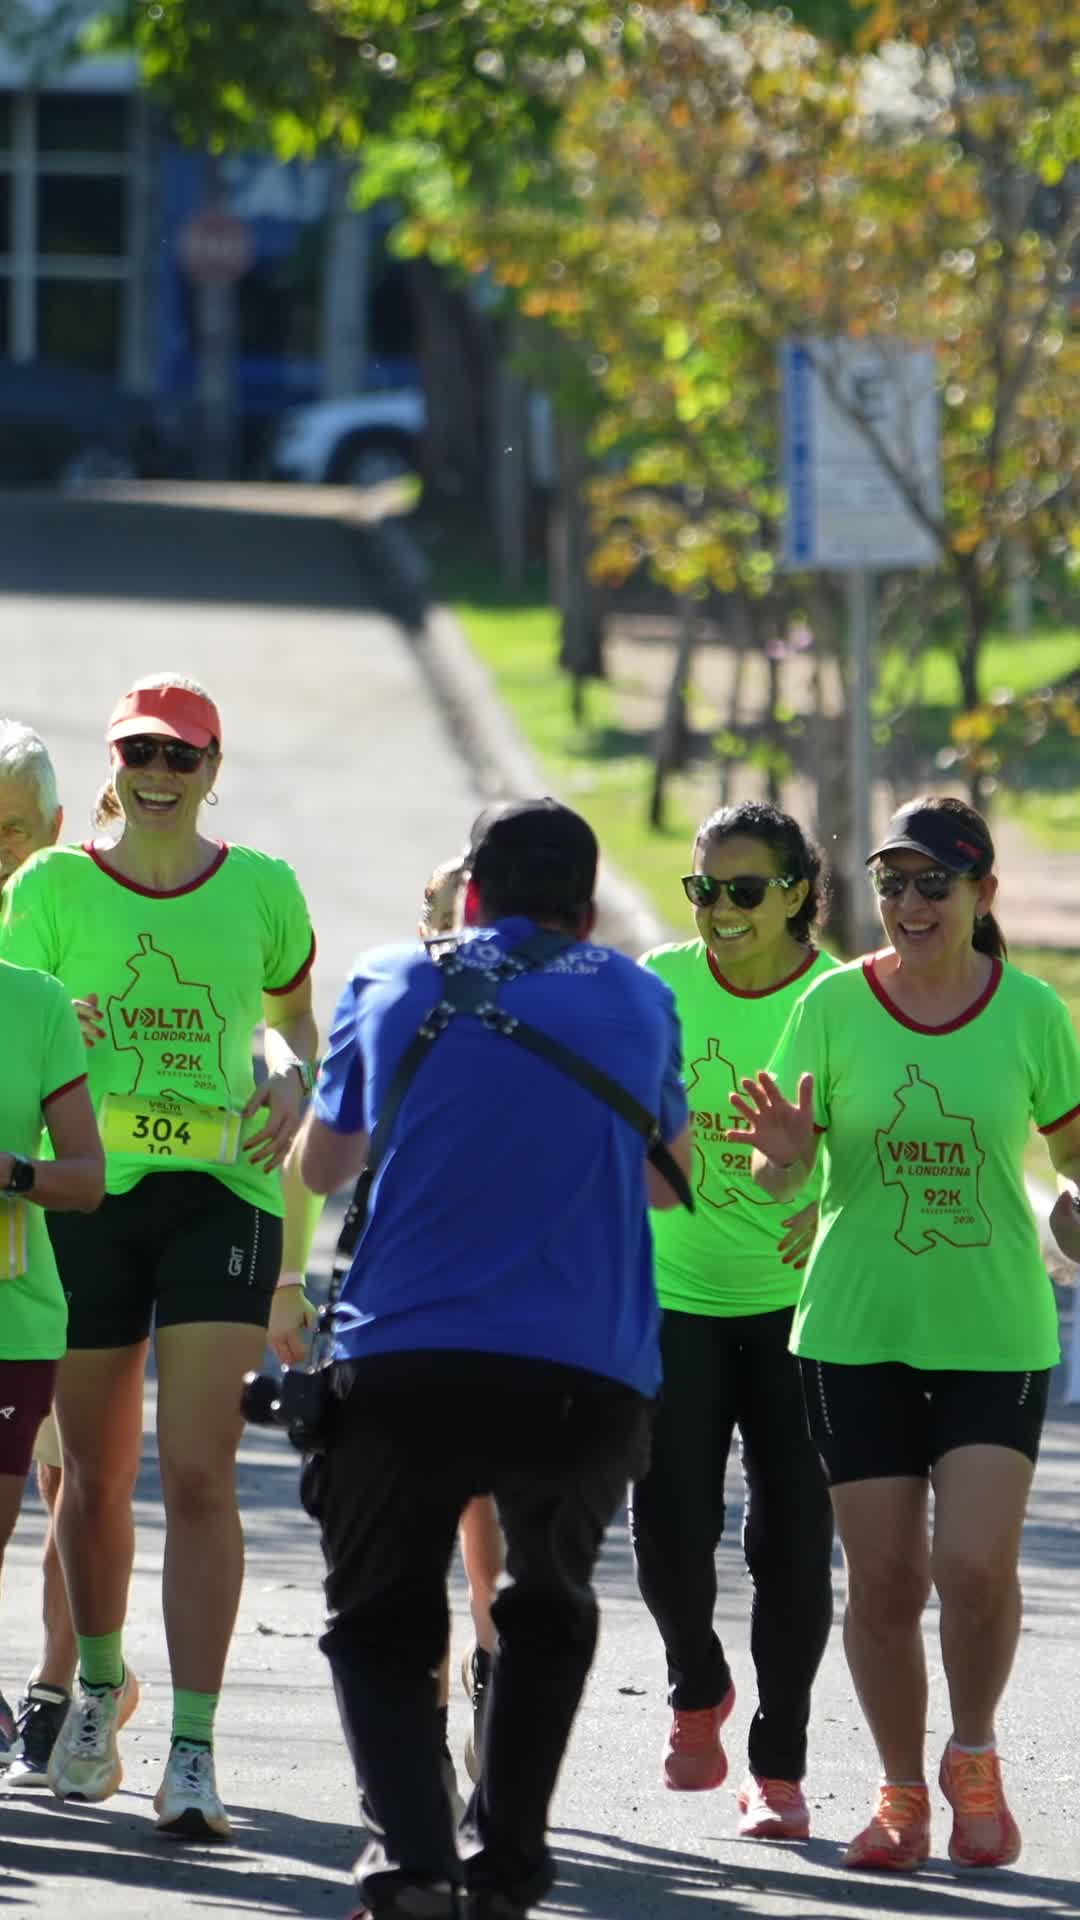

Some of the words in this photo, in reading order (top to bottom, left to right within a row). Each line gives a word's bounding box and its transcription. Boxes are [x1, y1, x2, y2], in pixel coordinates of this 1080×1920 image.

[120, 1007, 204, 1031] VOLTA
[143, 1031, 212, 1043] LONDRINA
[160, 1052, 203, 1072] 92K
[132, 1114, 191, 1145] 304
[887, 1141, 965, 1164] VOLTA
[908, 1165, 971, 1177] LONDRINA
[923, 1187, 962, 1207] 92K
